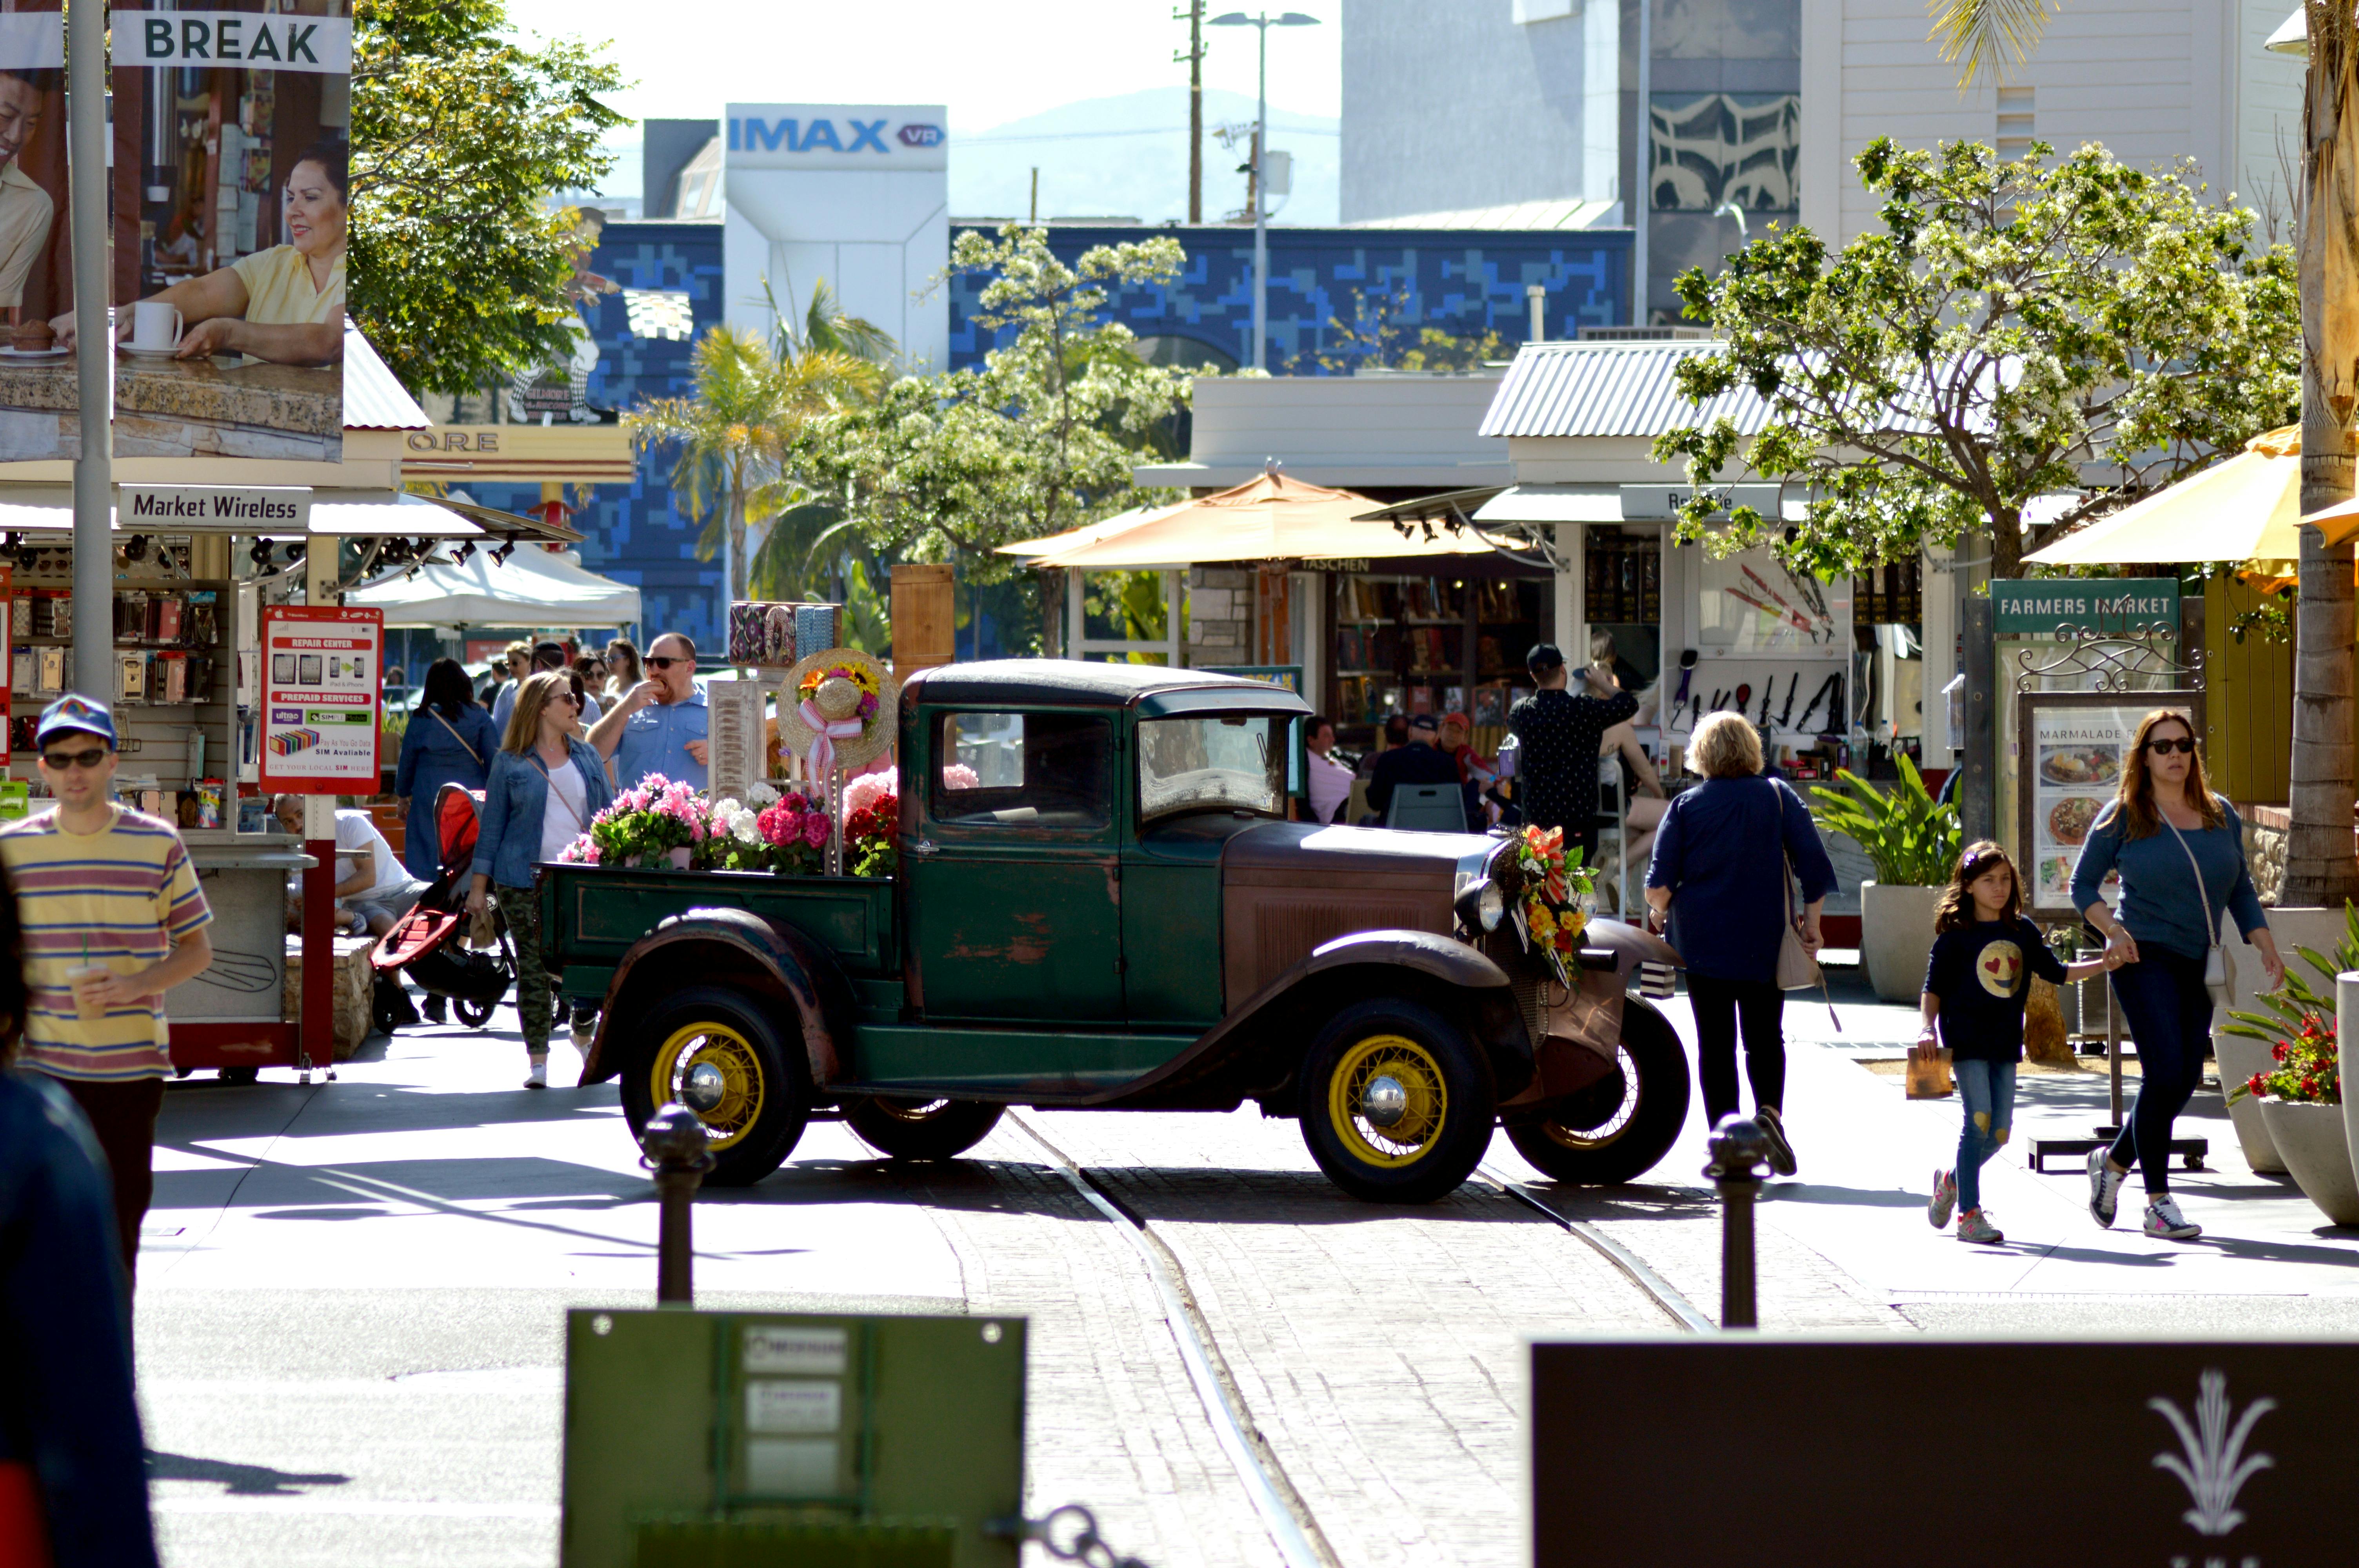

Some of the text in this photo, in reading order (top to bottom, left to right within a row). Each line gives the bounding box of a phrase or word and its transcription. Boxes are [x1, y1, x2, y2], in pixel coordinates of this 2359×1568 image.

[145, 19, 319, 64] BREAK
[729, 118, 937, 153] IMAX VR
[526, 388, 570, 401] GILMORE
[536, 401, 572, 411] RECORD
[134, 494, 296, 518] Market Wireless
[2001, 598, 2169, 615] FARMERS MARKET
[292, 639, 353, 648] REPAIR CENTER
[281, 693, 364, 703] PREPAID SERVICES
[2040, 730, 2121, 739] MARMALADE
[320, 739, 329, 748] Pay
